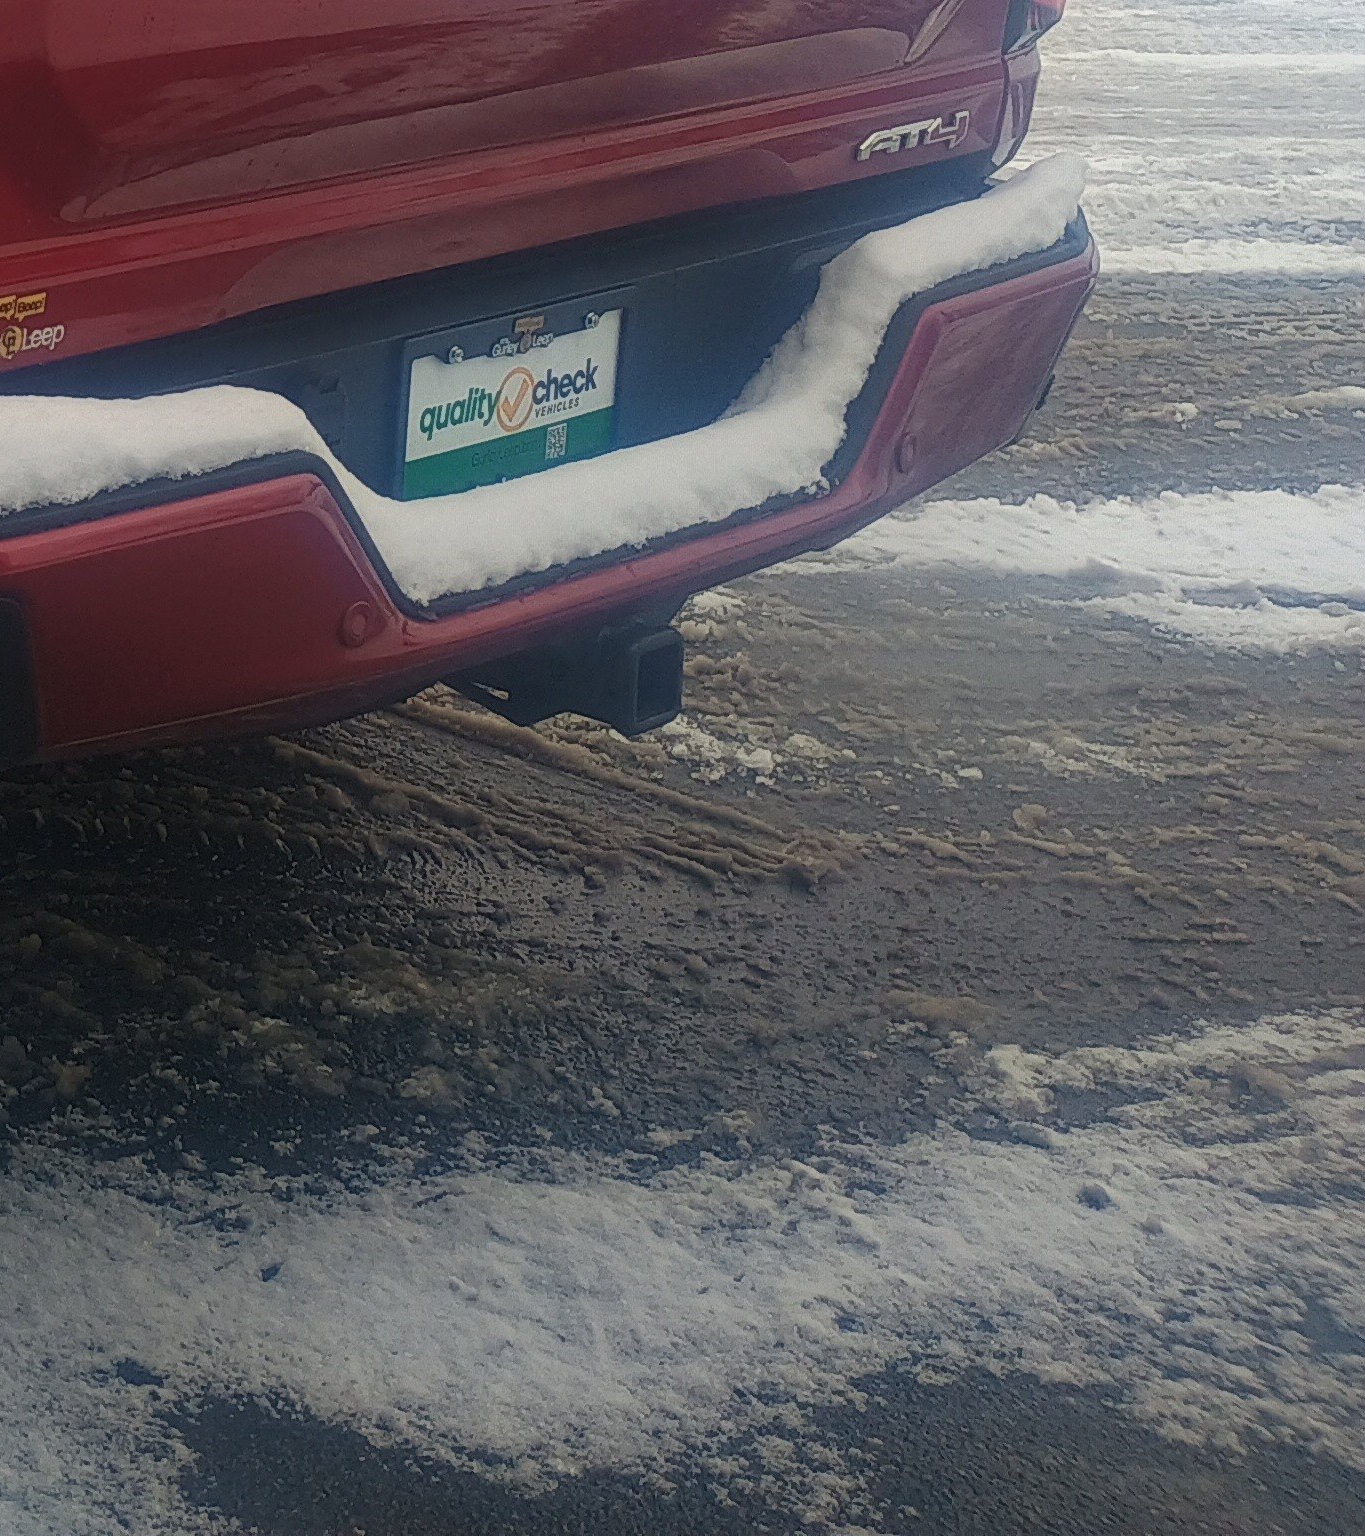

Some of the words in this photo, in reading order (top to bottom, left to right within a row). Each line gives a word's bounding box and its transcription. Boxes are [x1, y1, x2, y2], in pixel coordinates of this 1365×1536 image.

[856, 109, 971, 162] AT4
[21, 324, 65, 351] Leep
[419, 387, 503, 441] quality
[531, 357, 599, 405] check
[534, 396, 581, 419] VEHICLES
